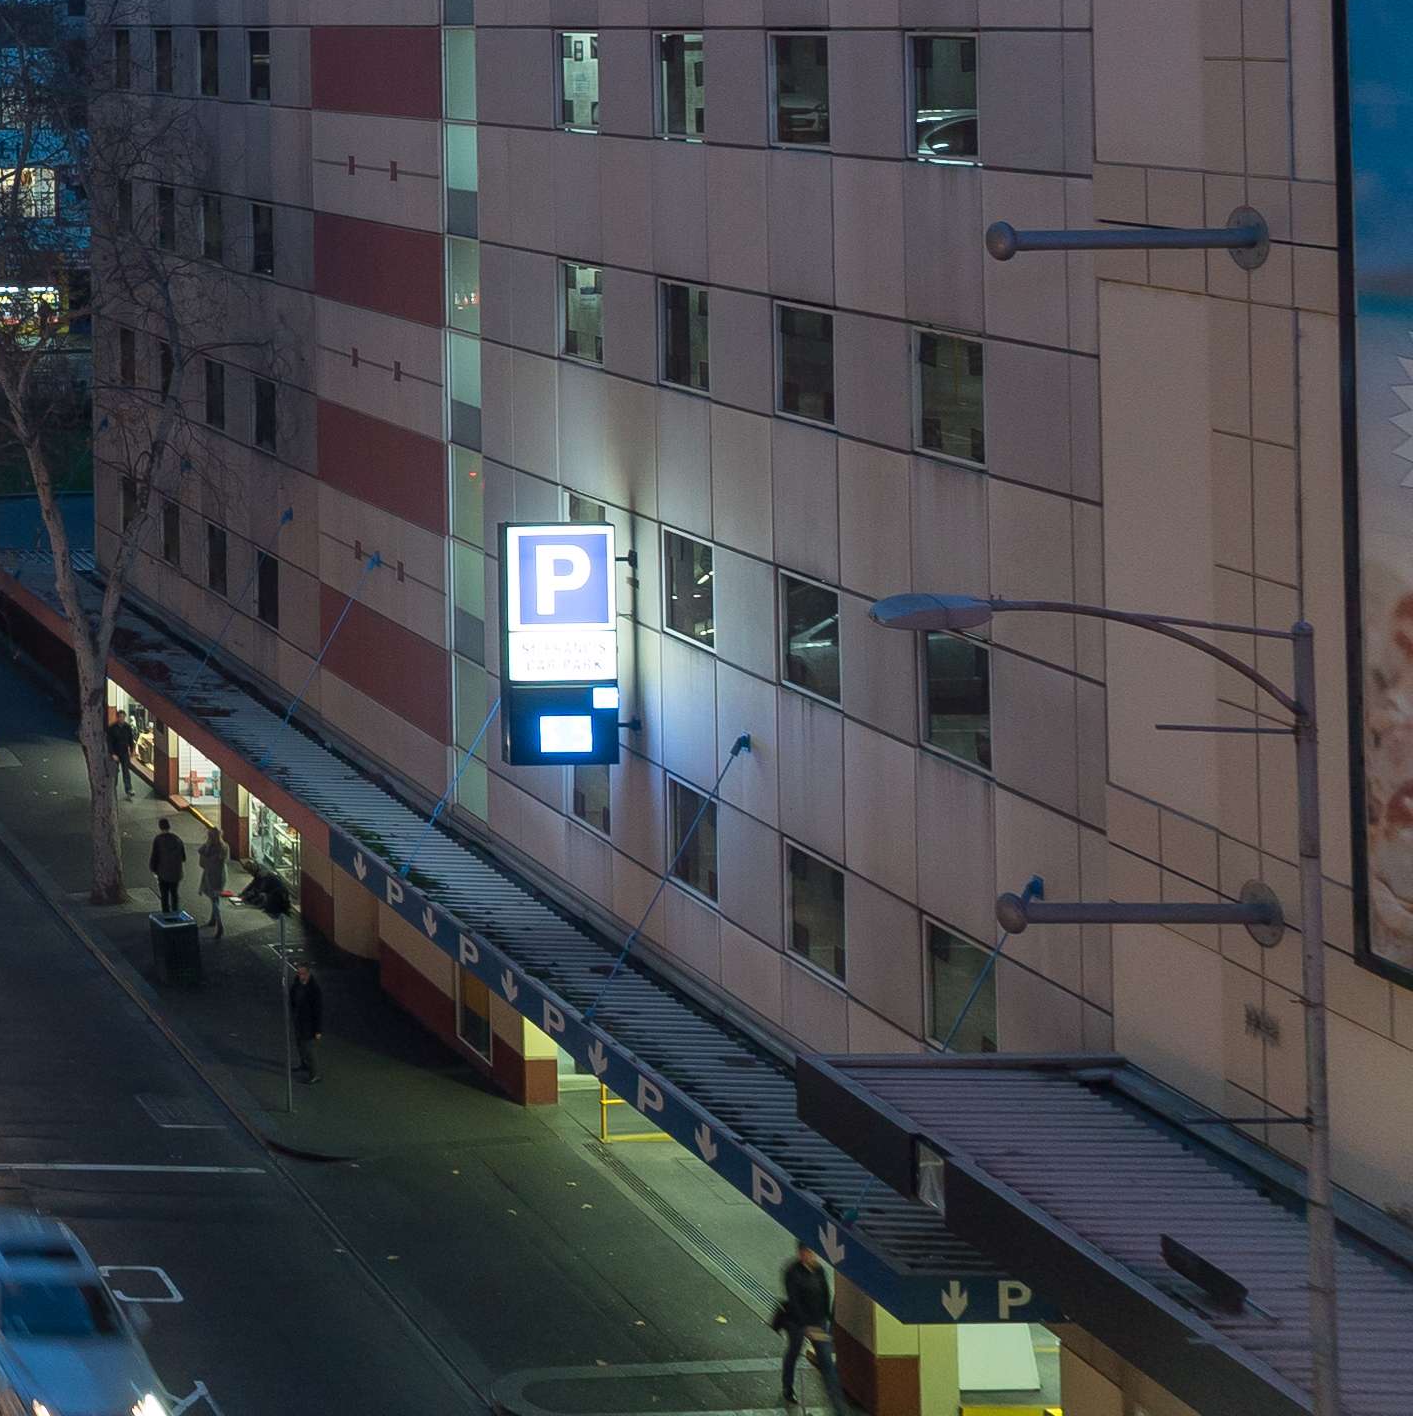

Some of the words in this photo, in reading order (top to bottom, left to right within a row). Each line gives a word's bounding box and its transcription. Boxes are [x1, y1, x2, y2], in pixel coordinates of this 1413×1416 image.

[535, 544, 591, 616] P
[386, 876, 404, 906] P
[459, 933, 479, 965] P
[542, 999, 566, 1034] P
[637, 1074, 664, 1112] P
[752, 1162, 782, 1205] P
[998, 1279, 1032, 1320] P
